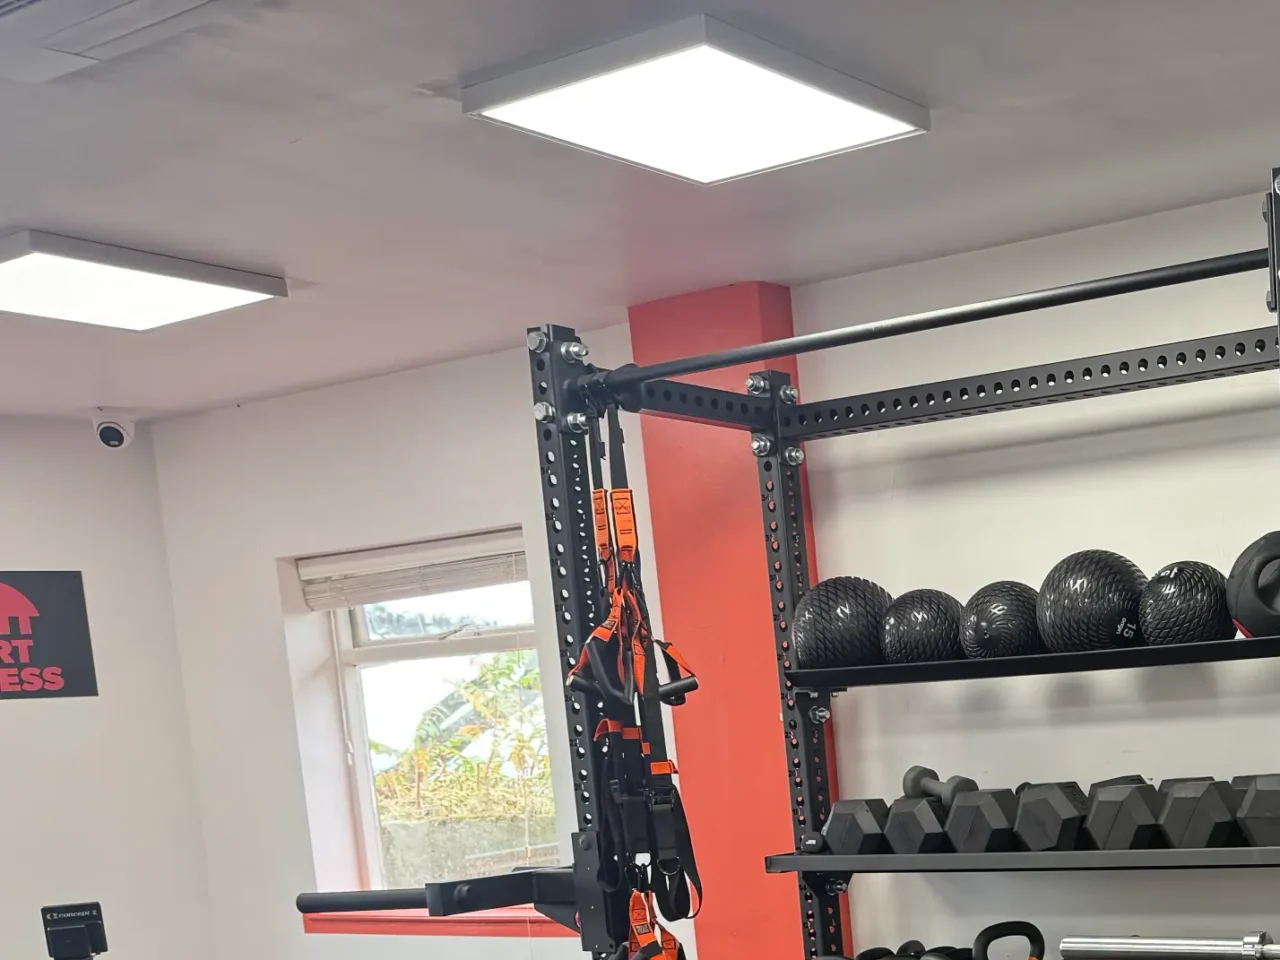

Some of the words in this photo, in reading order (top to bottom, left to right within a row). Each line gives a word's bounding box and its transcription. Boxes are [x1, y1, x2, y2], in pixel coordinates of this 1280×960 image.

[1123, 623, 1136, 638] 15
[0, 639, 34, 663] RT
[0, 667, 64, 691] ESS
